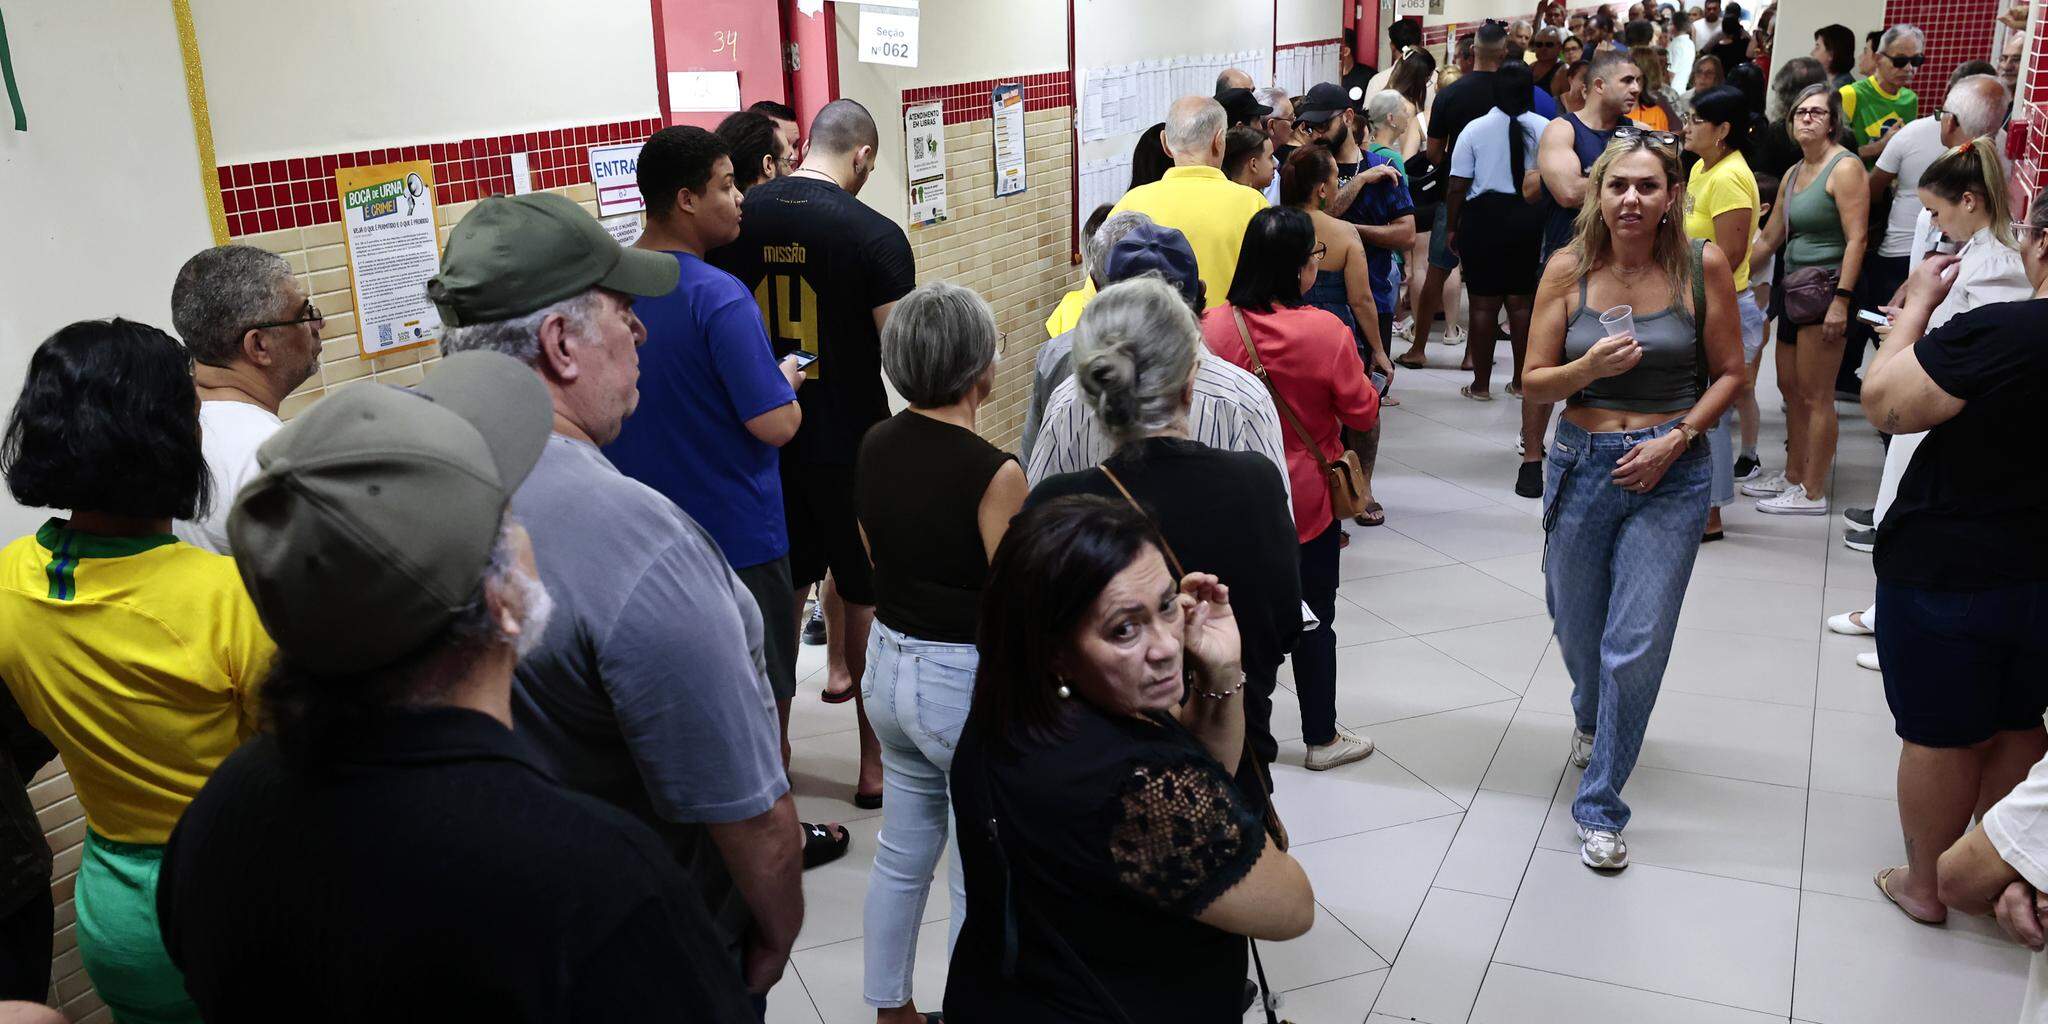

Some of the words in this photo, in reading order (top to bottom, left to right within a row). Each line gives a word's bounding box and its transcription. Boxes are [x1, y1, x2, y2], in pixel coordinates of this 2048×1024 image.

[876, 26, 905, 39] Seção
[712, 29, 738, 61] 34
[909, 109, 940, 121] ATENDIMENTO
[912, 120, 920, 128] EM
[920, 118, 937, 127] LIBRAS
[349, 189, 372, 206] BOCA
[380, 180, 403, 197] URNA
[371, 200, 396, 216] CRIME!
[763, 242, 807, 264] MISSÃO
